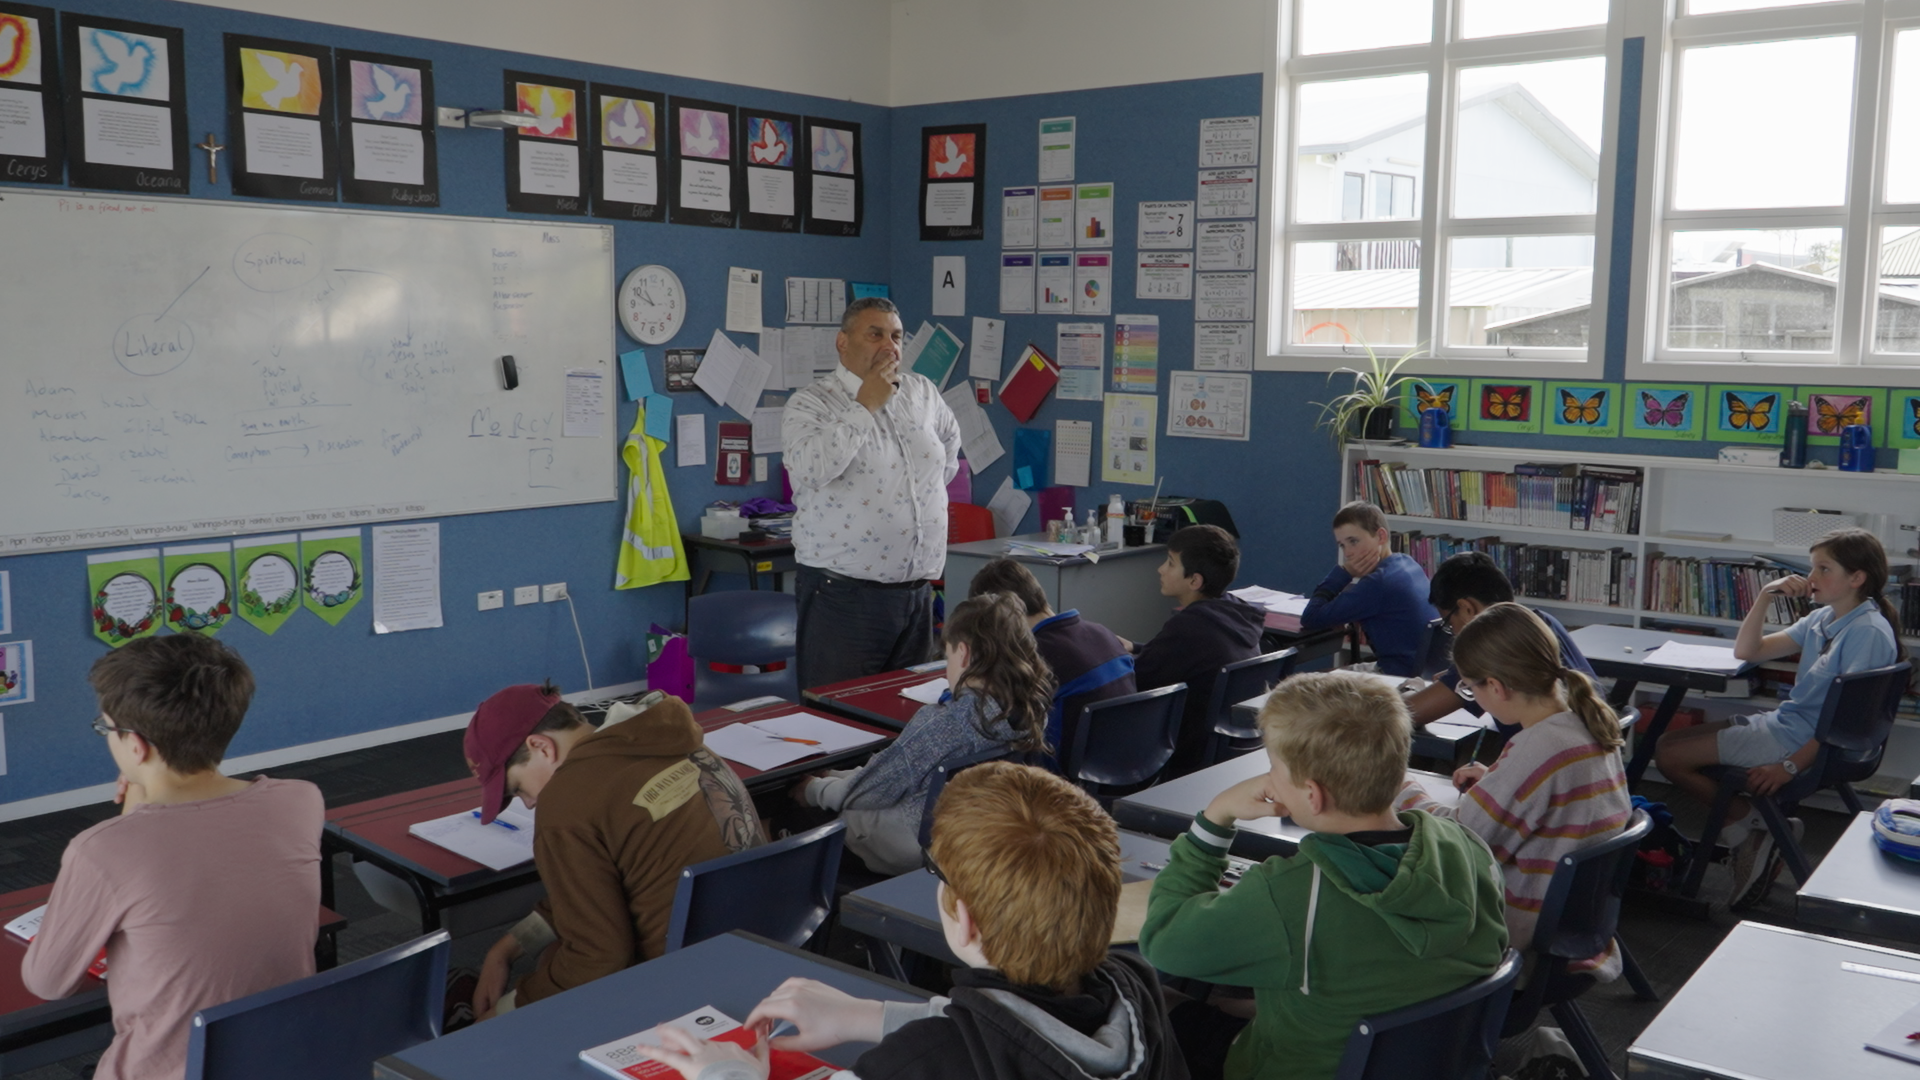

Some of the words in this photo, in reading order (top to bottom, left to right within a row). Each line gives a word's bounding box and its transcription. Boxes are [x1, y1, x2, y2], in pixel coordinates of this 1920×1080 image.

[7, 158, 48, 180] Cerys
[136, 170, 182, 189] Oceana
[299, 180, 335, 197] Gemma
[58, 198, 70, 212] Pi
[76, 201, 84, 210] is
[1178, 214, 1184, 224] 7
[1177, 226, 1183, 237] 8
[541, 232, 561, 244] Mass
[243, 251, 307, 274] Spiritual
[639, 278, 647, 287] 11
[649, 274, 658, 283] 12
[661, 278, 665, 287] 1
[942, 270, 955, 289] A
[632, 287, 642, 296] 10
[667, 288, 672, 296] 2
[630, 299, 636, 309] 9
[670, 300, 675, 309] 3
[633, 312, 639, 321] 8
[666, 313, 672, 321] 4
[641, 322, 646, 331] 7
[650, 326, 655, 335] 6
[659, 322, 665, 332] 5
[125, 330, 186, 358] Literal
[25, 378, 77, 399] Adam
[31, 408, 87, 421] Moses
[1175, 415, 1182, 426] 2
[60, 463, 101, 483] David
[643, 777, 674, 804] OBI-WAN
